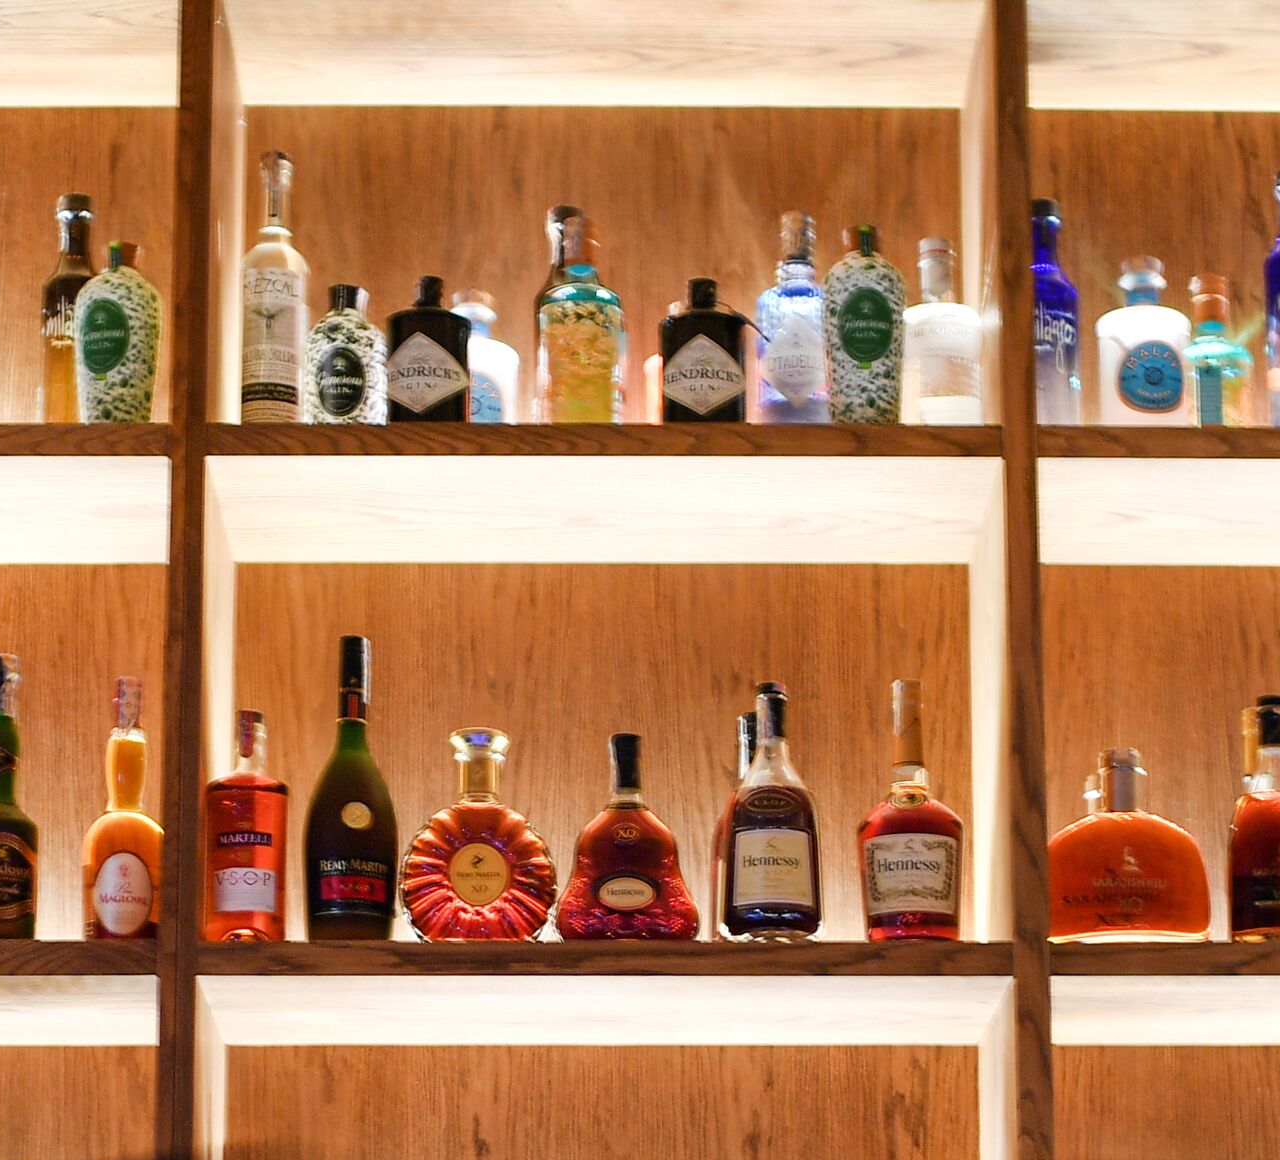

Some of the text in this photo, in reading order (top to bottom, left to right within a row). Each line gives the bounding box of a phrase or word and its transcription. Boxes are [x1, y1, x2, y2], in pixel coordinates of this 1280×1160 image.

[243, 276, 299, 297] MEZCAL
[663, 369, 740, 385] HENDRICK'S
[219, 833, 271, 845] MARTELL
[617, 827, 637, 838] XO
[742, 854, 800, 870] Hennessy
[877, 857, 942, 874] Hennessy
[606, 885, 646, 898] Hennessy
